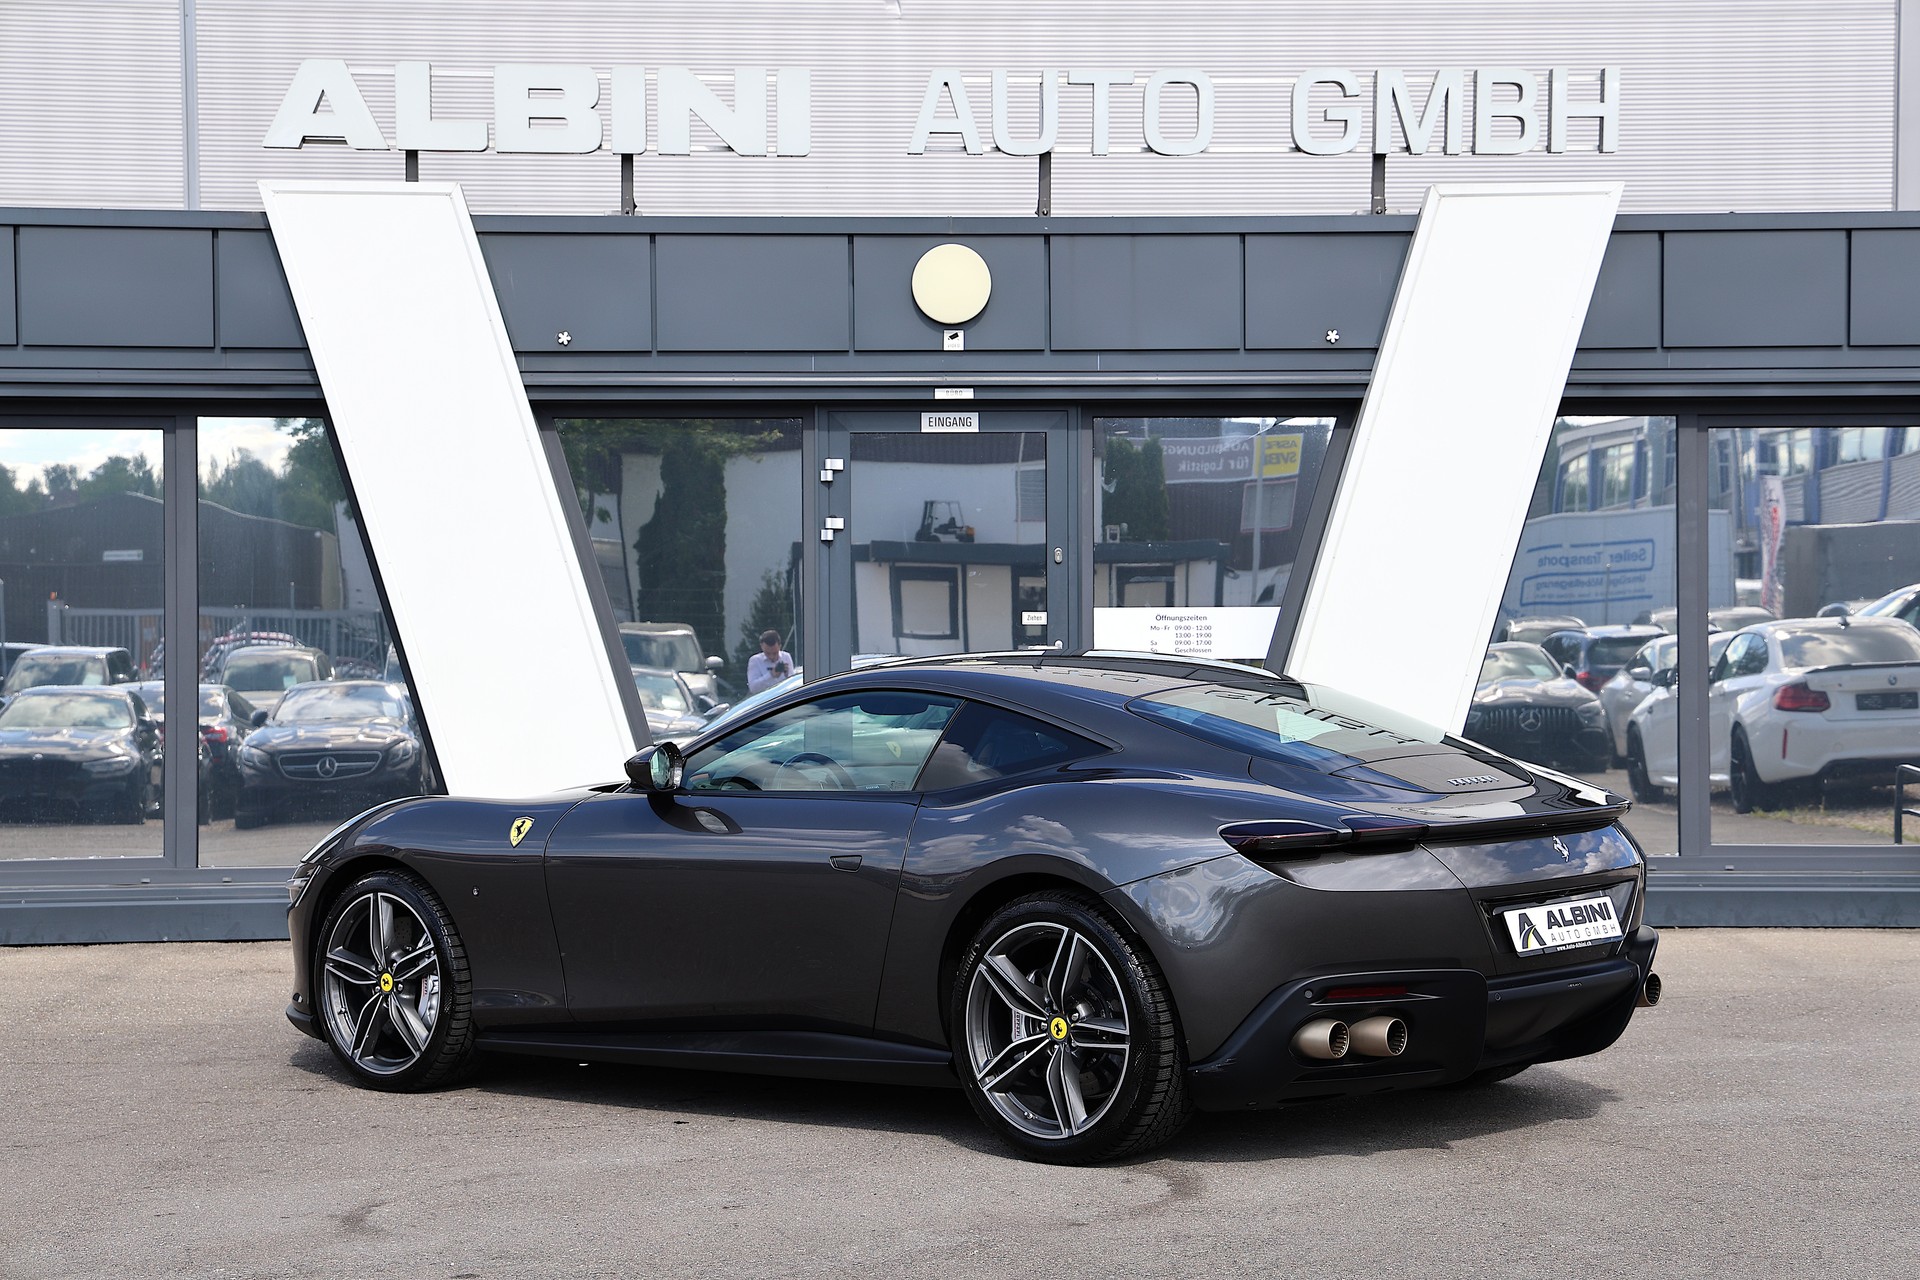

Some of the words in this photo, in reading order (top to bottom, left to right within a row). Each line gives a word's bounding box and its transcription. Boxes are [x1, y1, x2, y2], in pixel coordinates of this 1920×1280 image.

[262, 58, 811, 157] ALBINI
[907, 67, 1215, 156] AUTO
[1290, 67, 1621, 156] GMBH
[928, 416, 972, 427] EINGANG
[1155, 613, 1208, 622] Öffnungszeiten
[1546, 902, 1613, 930] ALBINI
[1551, 929, 1581, 942] AUTO
[1585, 923, 1617, 937] GMBH
